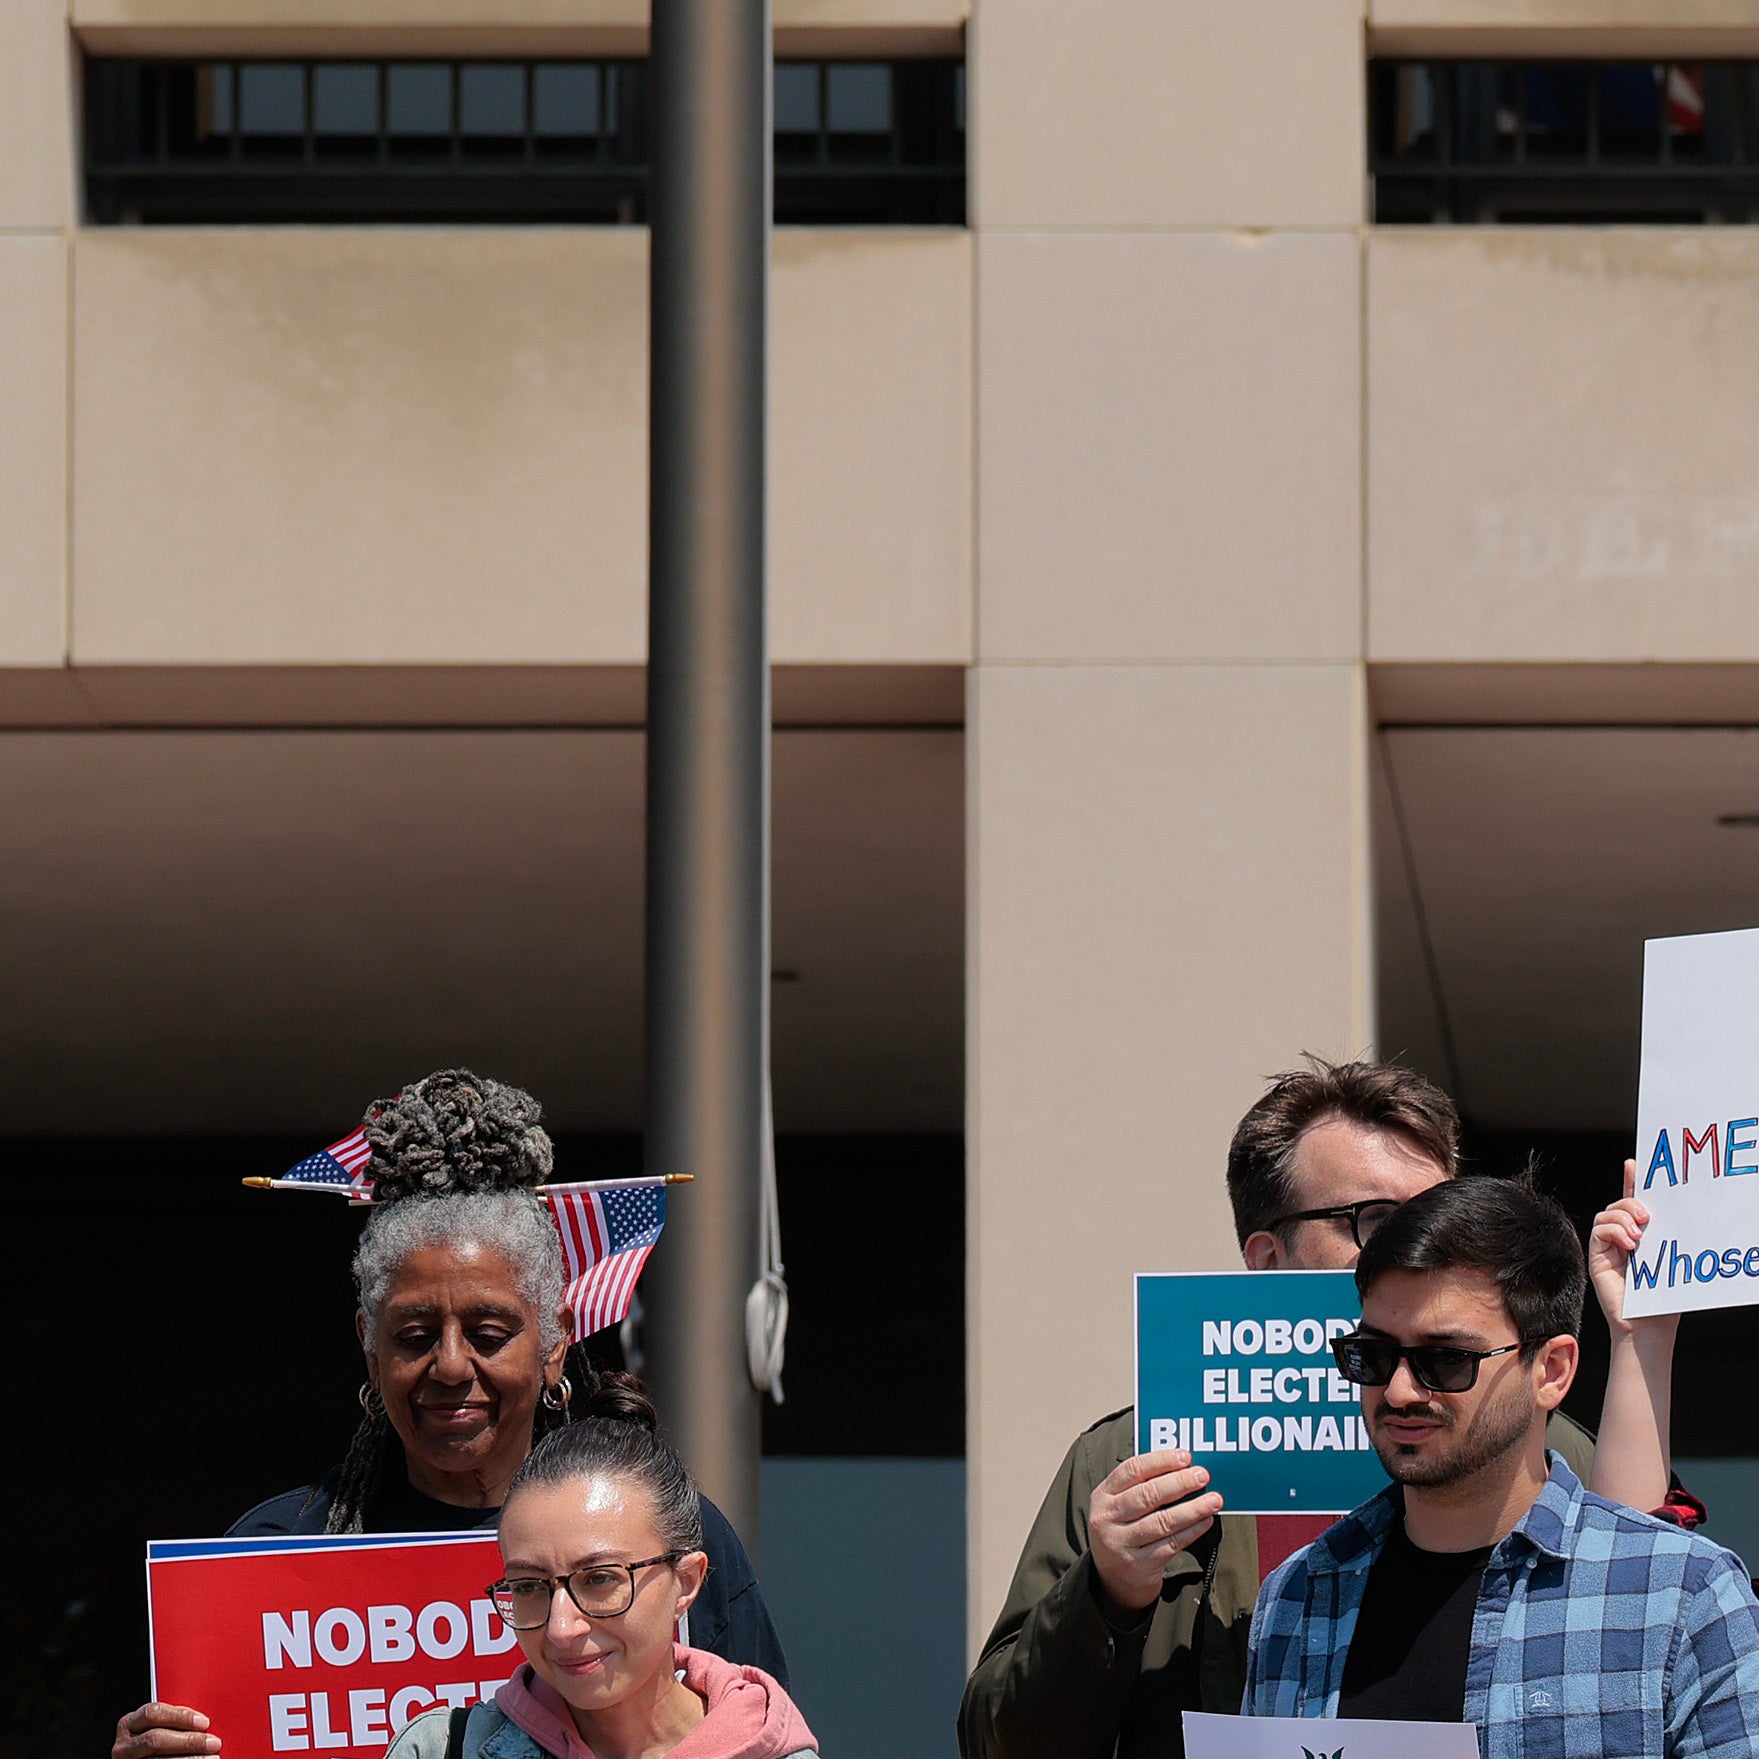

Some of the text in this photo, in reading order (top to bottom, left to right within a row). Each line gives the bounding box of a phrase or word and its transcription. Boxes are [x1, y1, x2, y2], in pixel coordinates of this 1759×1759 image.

[1202, 1318, 1362, 1356] NOBOD
[262, 1598, 519, 1670] NOBOD
[268, 1678, 511, 1752] ELECT
